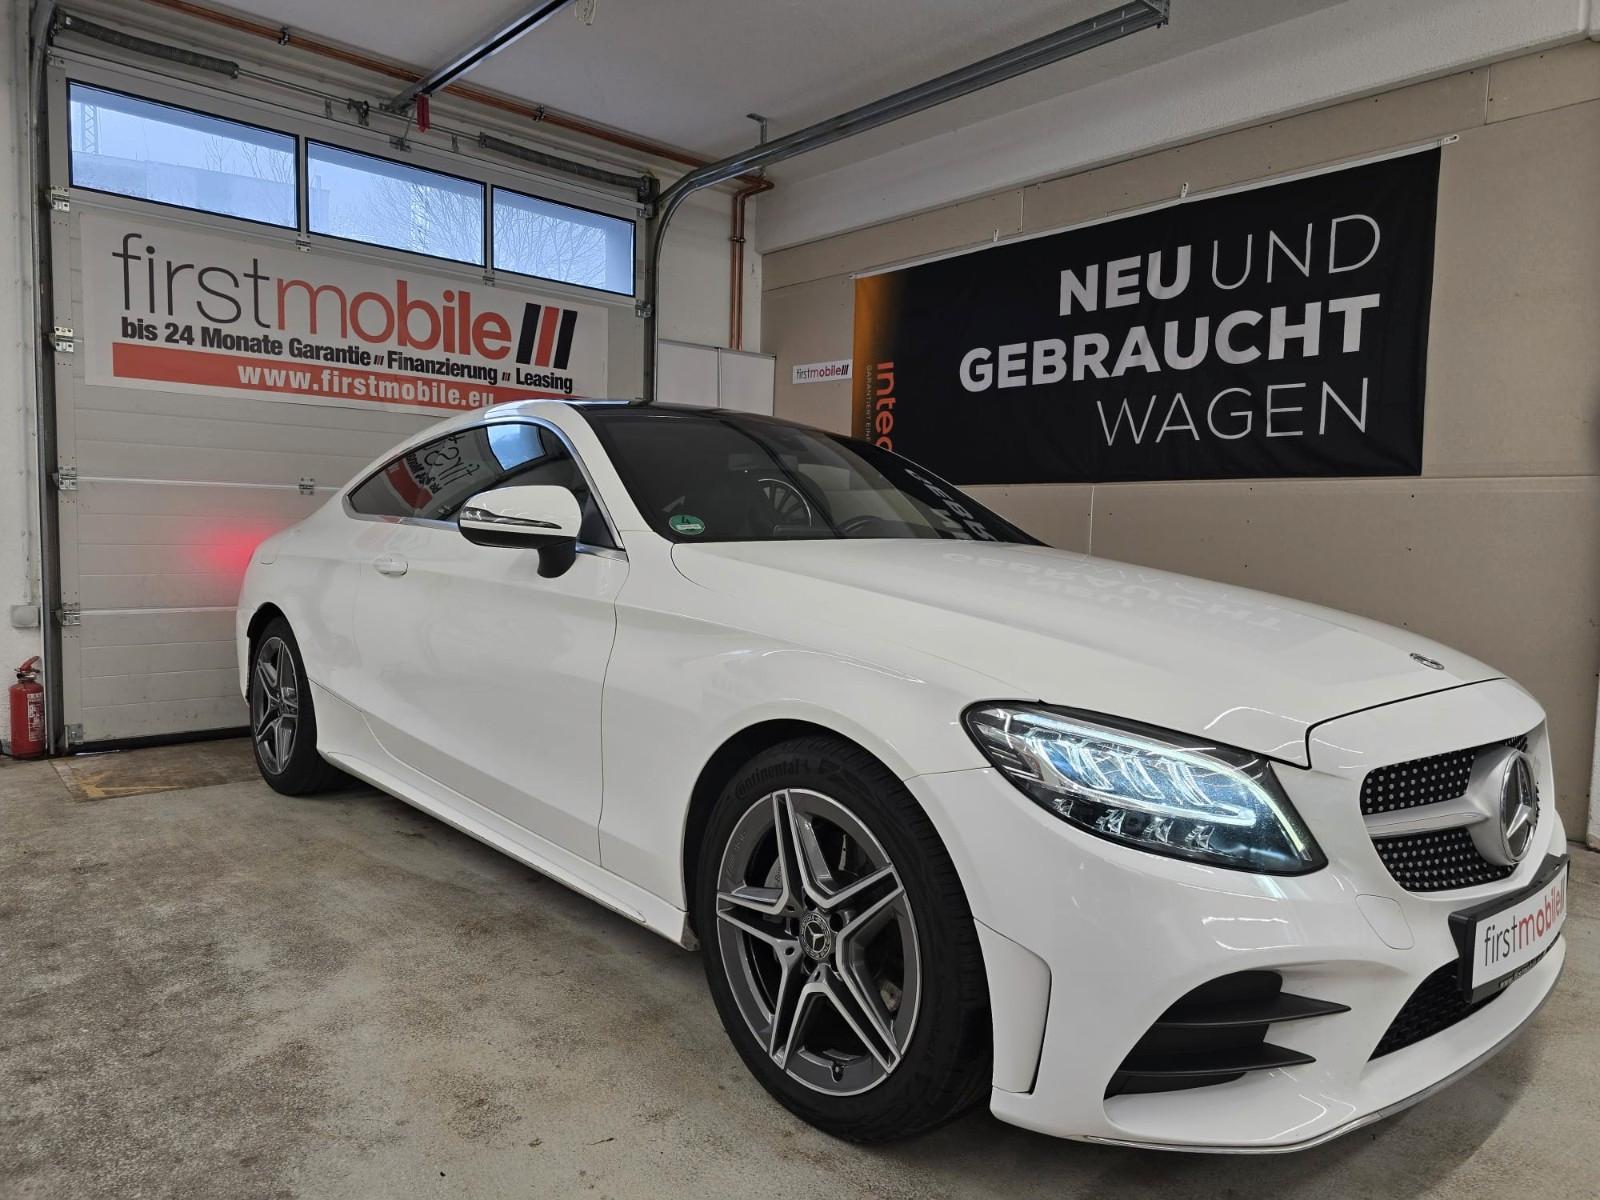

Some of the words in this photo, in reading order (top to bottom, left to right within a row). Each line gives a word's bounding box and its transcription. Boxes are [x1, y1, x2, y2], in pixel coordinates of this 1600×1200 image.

[112, 233, 513, 361] firstmobile
[1058, 244, 1193, 317] NEU
[1211, 213, 1382, 291] UND
[121, 316, 158, 342] bis
[164, 322, 195, 346] 24
[200, 326, 284, 356] Monate
[288, 337, 372, 367] Garantie
[386, 349, 498, 386] Finanzierung
[515, 367, 573, 395] Leasing
[796, 365, 842, 380] firstmobile
[958, 293, 1381, 393] GEBRAUCHT
[237, 365, 494, 407] www.firstmobile.eu
[1096, 377, 1370, 448] WAGEN
[735, 757, 801, 799] Continental
[1484, 884, 1560, 967] firstmobile
